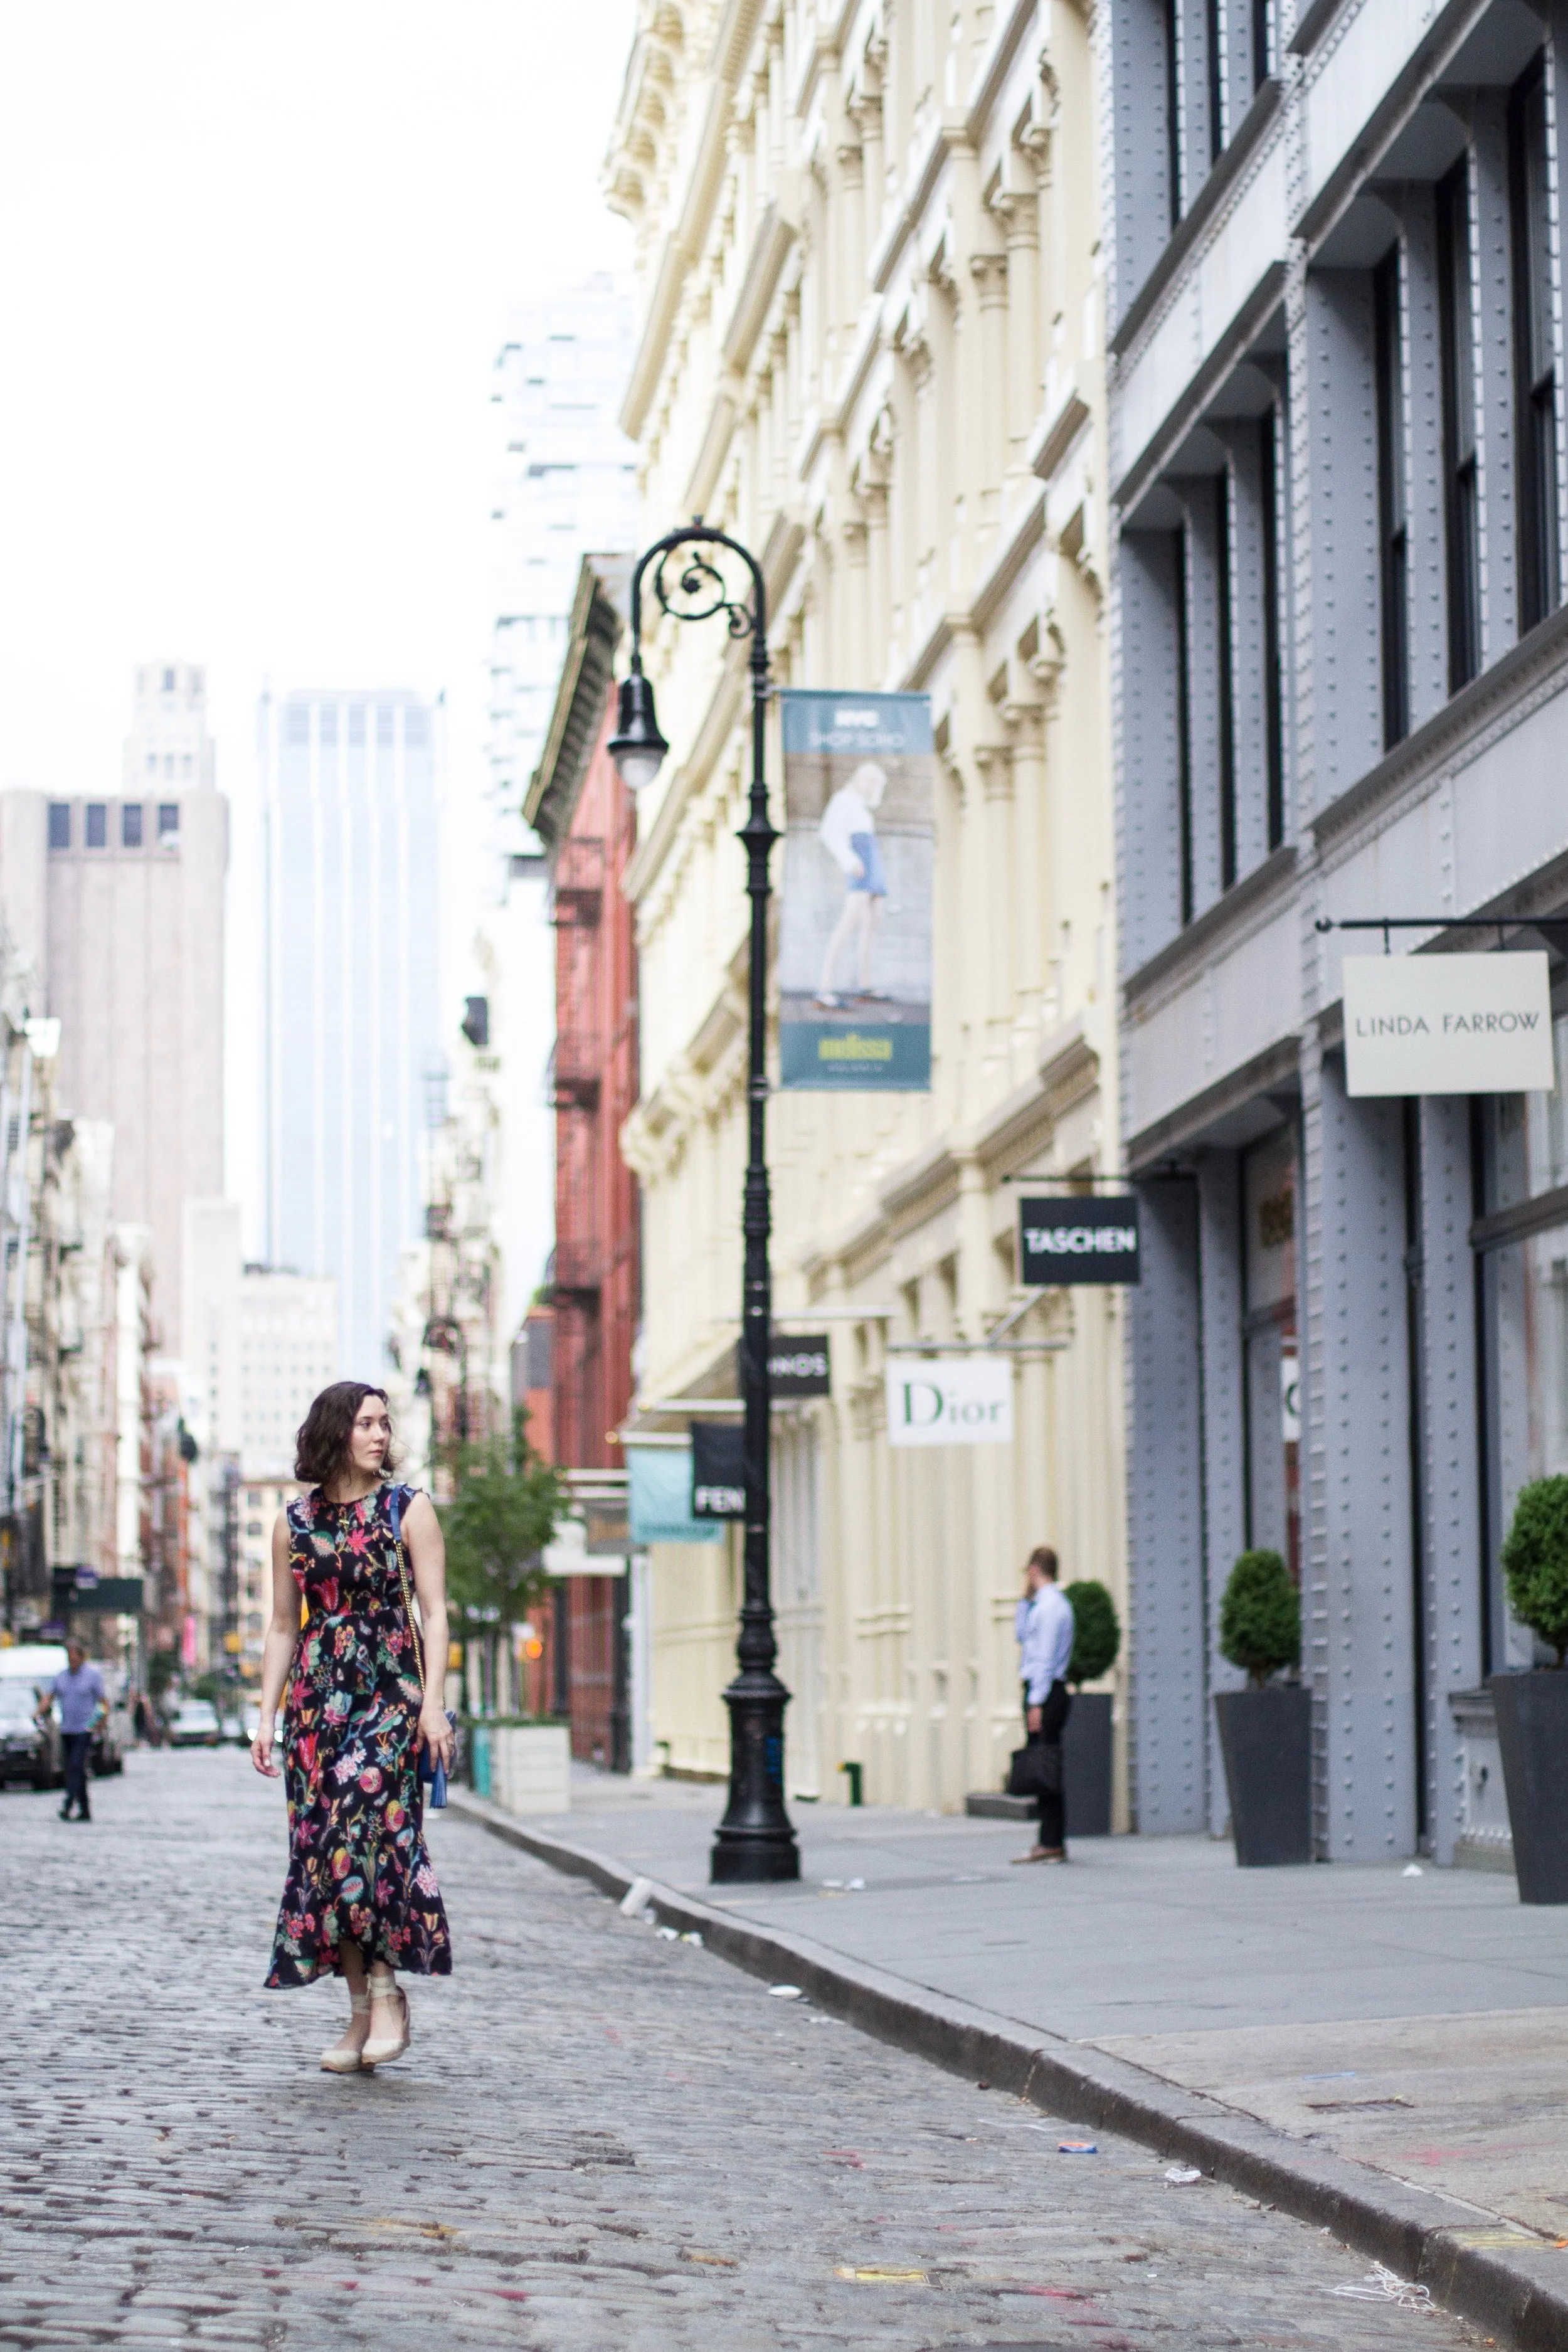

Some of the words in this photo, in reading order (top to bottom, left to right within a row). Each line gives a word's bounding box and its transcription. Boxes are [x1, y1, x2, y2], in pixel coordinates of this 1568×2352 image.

[1355, 1014, 1429, 1037] LINDA
[1442, 1010, 1539, 1034] FARROW
[1024, 1226, 1136, 1253] TASCHEN
[901, 1381, 1004, 1426] Dior
